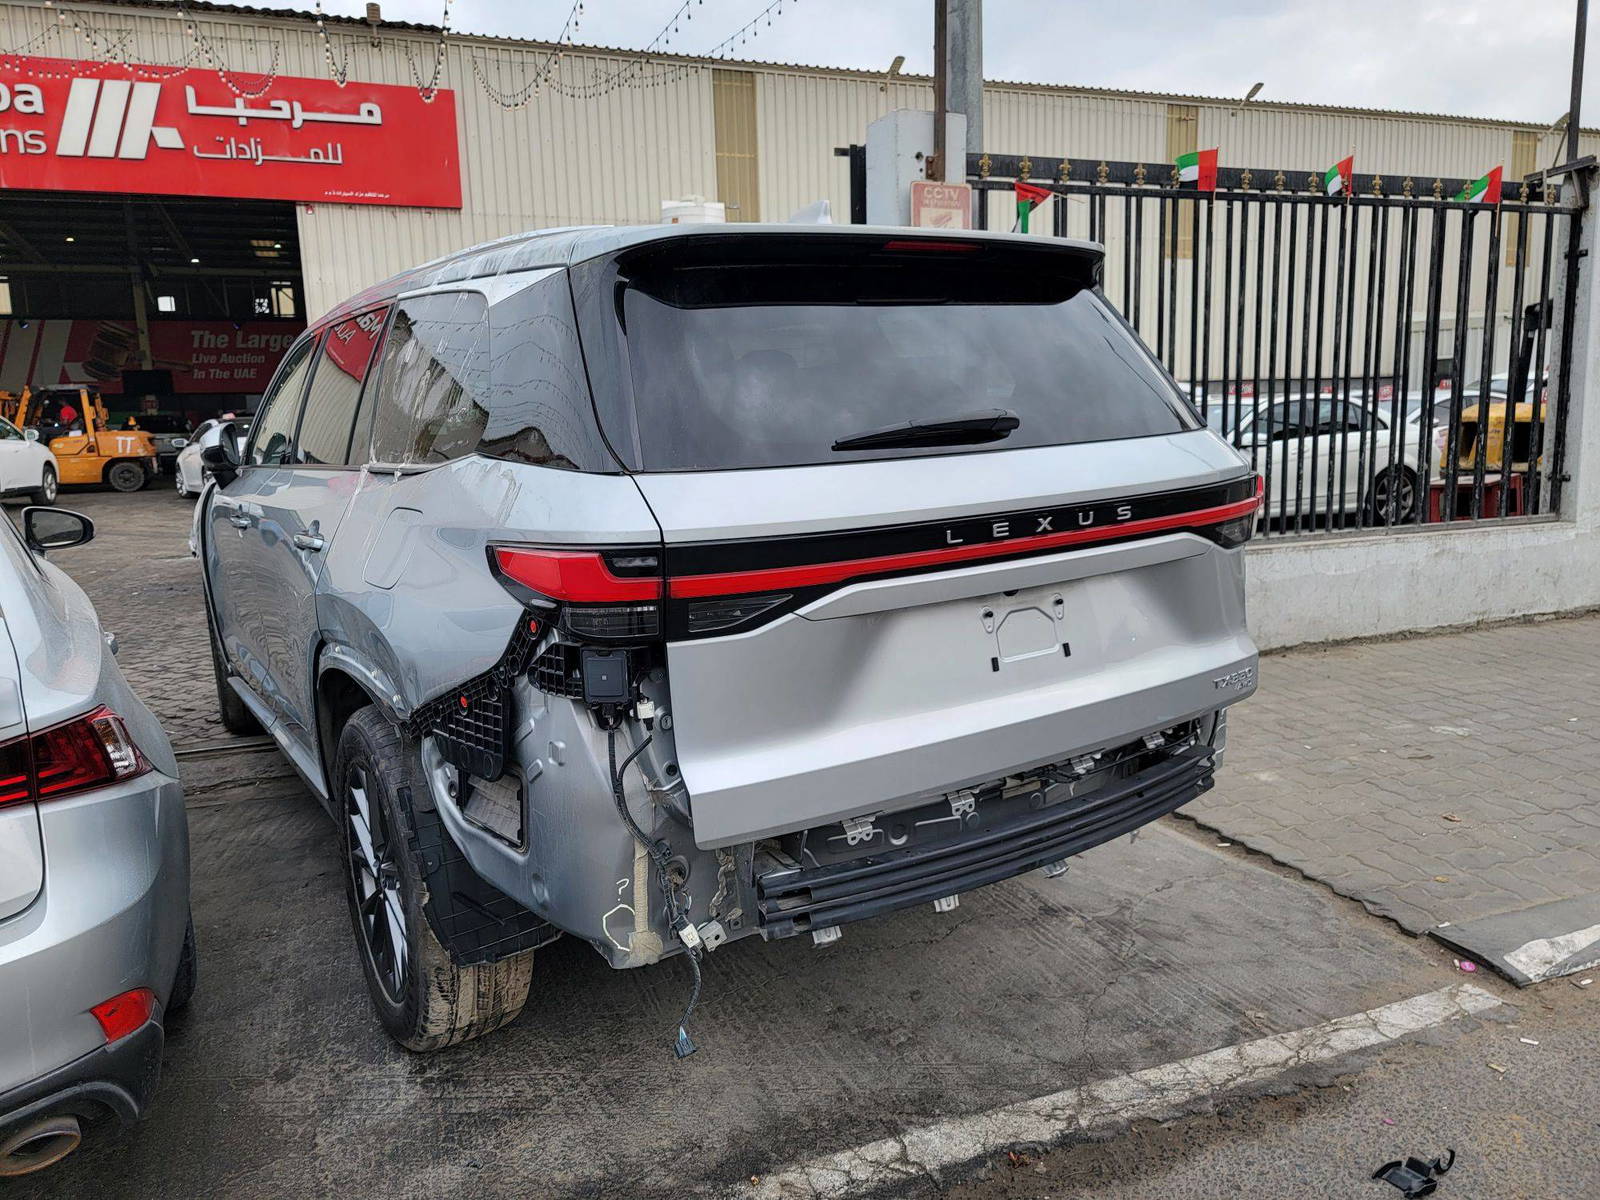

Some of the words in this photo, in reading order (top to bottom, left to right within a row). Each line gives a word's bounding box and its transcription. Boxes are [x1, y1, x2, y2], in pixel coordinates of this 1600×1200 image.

[185, 84, 383, 129] مرحبا
[193, 136, 343, 166] للمزادات
[923, 186, 960, 200] CCTV
[191, 330, 229, 348] The
[192, 353, 217, 364] Live
[219, 353, 265, 364] Auction
[208, 368, 230, 379] The
[234, 368, 257, 378] UAE
[946, 505, 1132, 544] LEXUS
